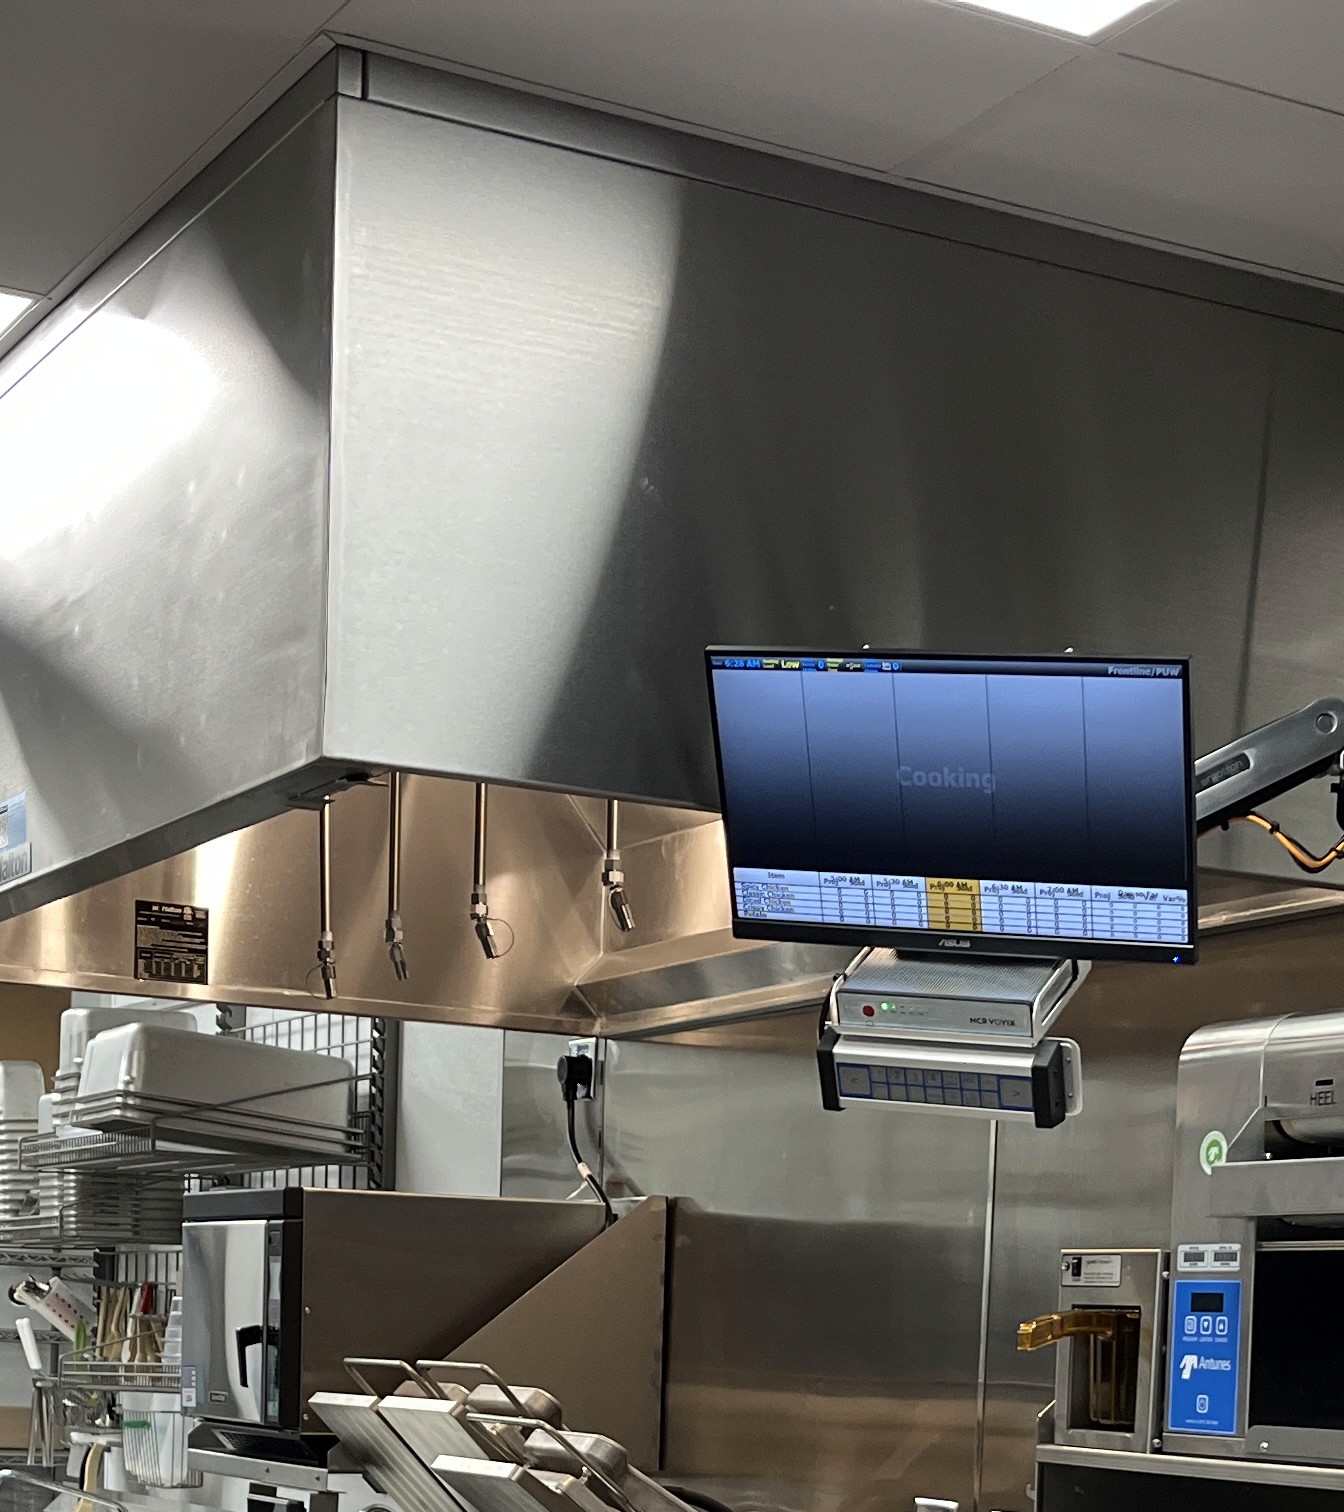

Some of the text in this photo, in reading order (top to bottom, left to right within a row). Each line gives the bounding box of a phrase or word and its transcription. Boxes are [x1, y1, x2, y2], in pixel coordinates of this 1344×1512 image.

[780, 659, 800, 669] Low
[896, 766, 997, 794] Cooking
[1309, 1090, 1338, 1107] HEEL
[1198, 1355, 1232, 1372] Antunes
